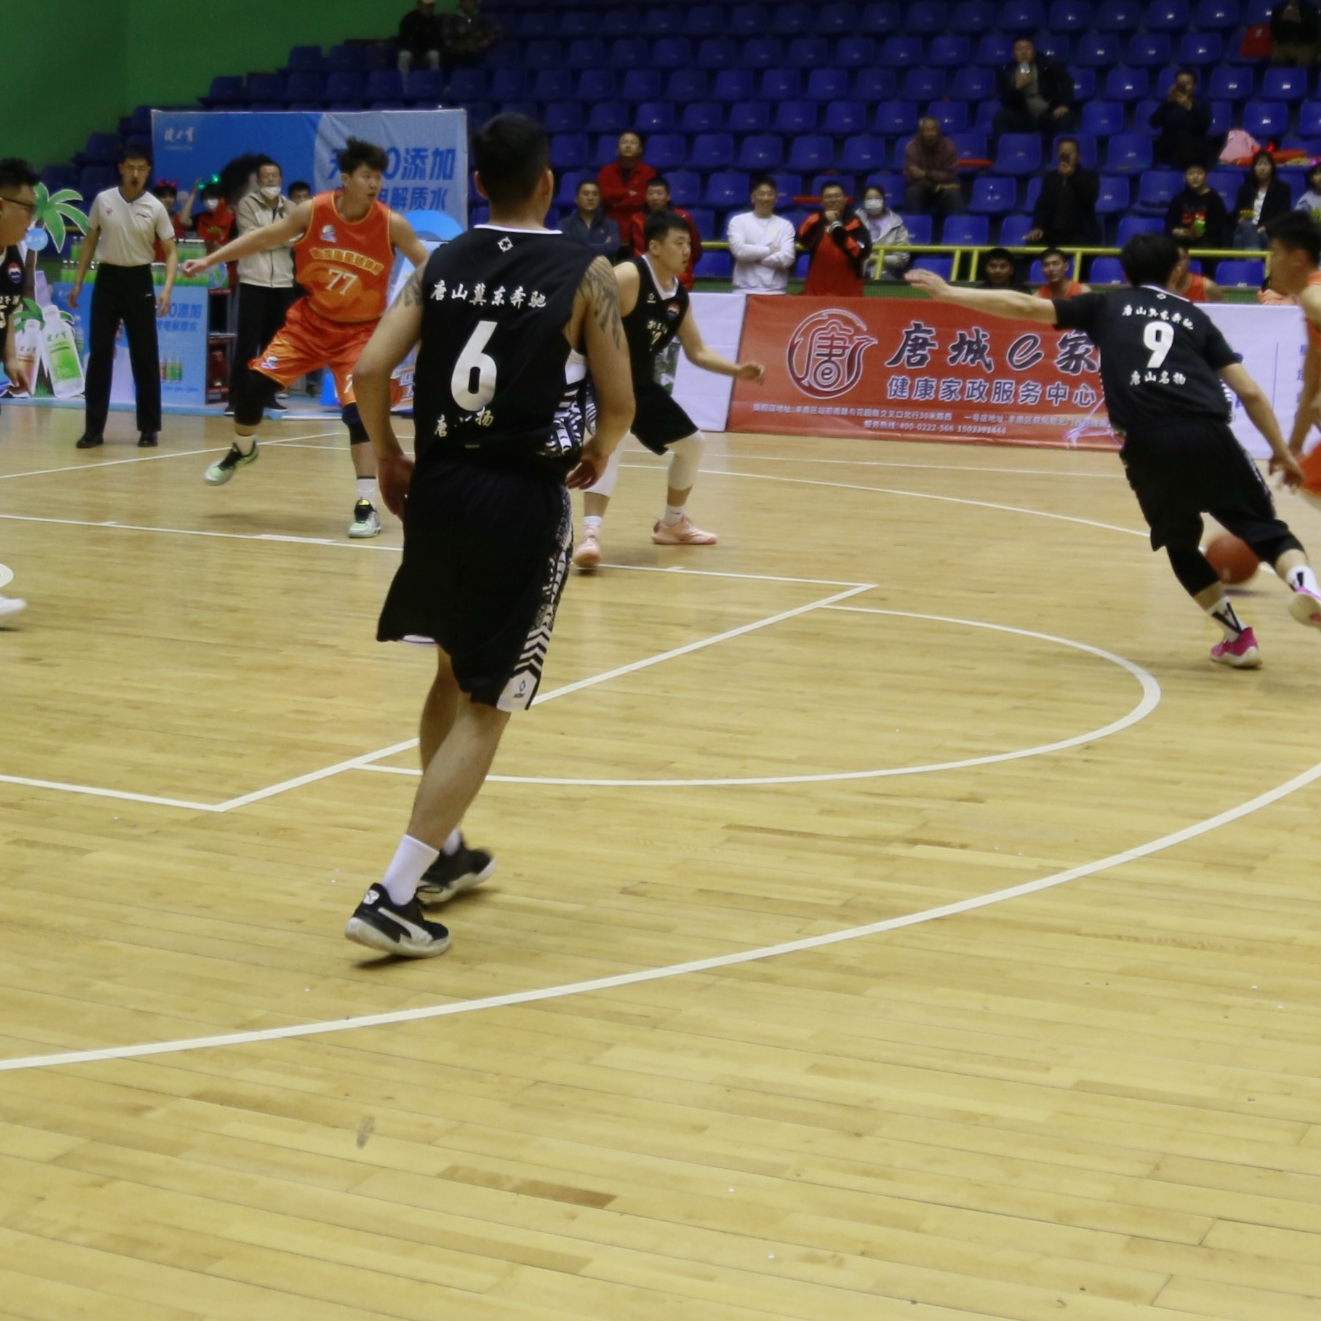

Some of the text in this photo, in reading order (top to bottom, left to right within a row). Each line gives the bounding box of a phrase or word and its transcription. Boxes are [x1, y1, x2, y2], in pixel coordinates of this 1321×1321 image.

[325, 268, 358, 296] 77
[451, 320, 498, 411] 6
[885, 320, 1101, 375] 唐城e家
[1143, 320, 1174, 368] 9
[886, 375, 1097, 407] 健康家政服务中心
